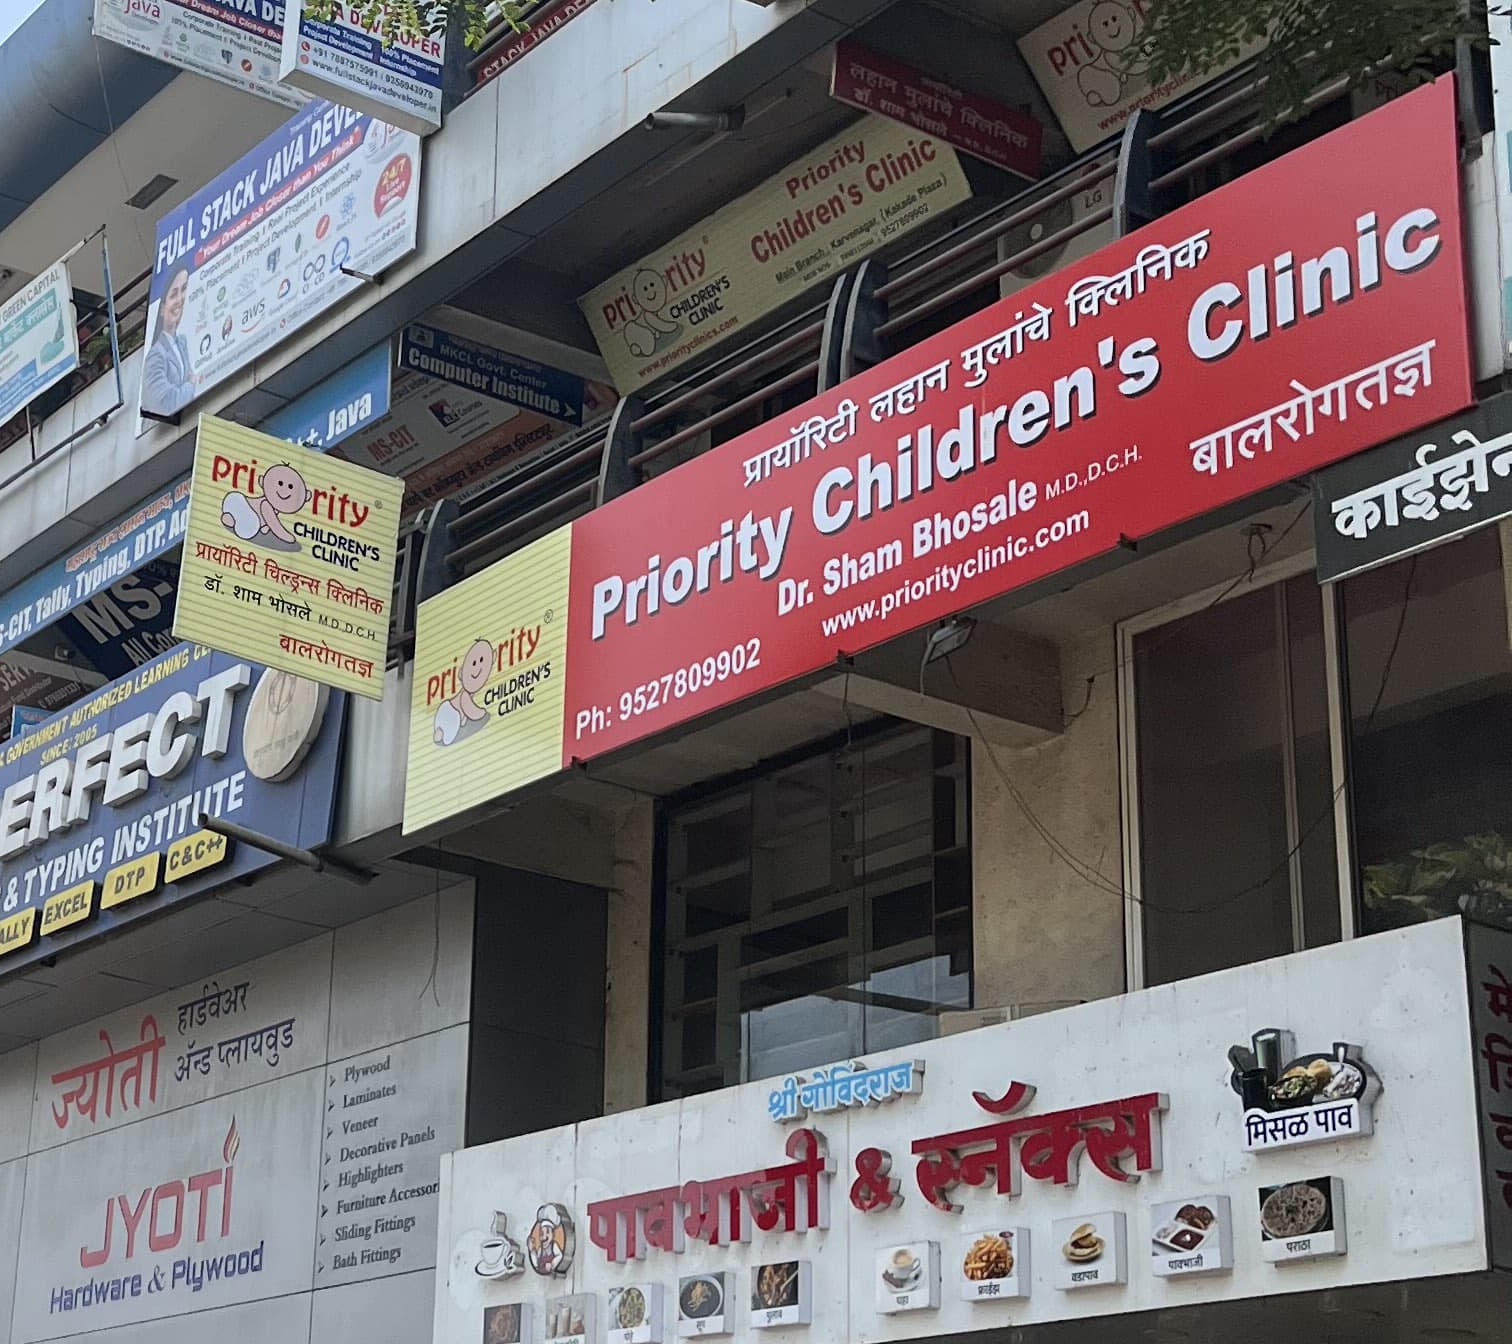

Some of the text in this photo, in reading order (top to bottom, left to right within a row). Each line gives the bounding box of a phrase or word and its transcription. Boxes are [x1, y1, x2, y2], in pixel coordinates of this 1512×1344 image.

[785, 140, 867, 200] Priority
[155, 134, 304, 274] FULL STACK JAVA
[751, 138, 937, 263] Children's Clinic
[688, 299, 724, 326] CLINIC
[408, 347, 489, 390] Computer
[492, 376, 561, 416] Institute
[740, 227, 1213, 489] प्रायॉरिटी लहान मुलांचे क्लिनिक
[326, 392, 372, 441] Java
[590, 206, 1443, 643] Priority Children's Clinic
[1188, 339, 1438, 477] बालरोगतज्ञ
[293, 521, 381, 562] CHILDREN'S
[311, 544, 361, 572] CLINIC
[777, 575, 816, 617] Dr.
[823, 537, 903, 598] Sham
[912, 479, 1039, 560] Bhosale
[195, 540, 385, 616] प्रायॉरिटी चिल्ड्रन्स क्लिनिक
[203, 574, 312, 622] डॉ. शाम भोसले
[821, 509, 1090, 640] www.priorityclinic.com
[279, 633, 375, 678] बालरोगतज्ञ
[7, 717, 69, 762] GOVERNMENT
[71, 683, 133, 730] AUTHORIZED
[135, 649, 190, 693] LEARNING
[484, 661, 552, 706] CHILDREN'S
[497, 688, 536, 718] CLINIC
[575, 636, 762, 741] Ph: 9527809902
[2, 876, 20, 913] &
[22, 836, 105, 906] TYPING
[110, 770, 248, 865] INSTITUTE
[43, 892, 88, 926] EXCEL
[113, 866, 147, 895] DTP
[51, 981, 250, 1129] ज्योती हार्डवेअर
[217, 1017, 296, 1069] प्लायवुड
[344, 1055, 391, 1084] Plywood
[768, 1058, 914, 1121] श्री गोविंदराज
[343, 1084, 397, 1109] Laminates
[339, 1126, 436, 1163] Decorative Panels
[342, 1115, 379, 1136] Veneer
[1245, 1103, 1354, 1147] मिसळ पाव
[338, 1162, 404, 1189] Highlighters
[587, 1080, 1163, 1263] पावभाजी & स्नॅक्स
[336, 1181, 440, 1215] Furniture Accessori
[335, 1214, 416, 1243] Sliding Fittings
[1285, 1238, 1312, 1255] पराठा
[50, 1241, 265, 1315] Hardware & Plywood
[333, 1246, 402, 1270] Bath Fittings
[1167, 1253, 1204, 1271] पावभाजी
